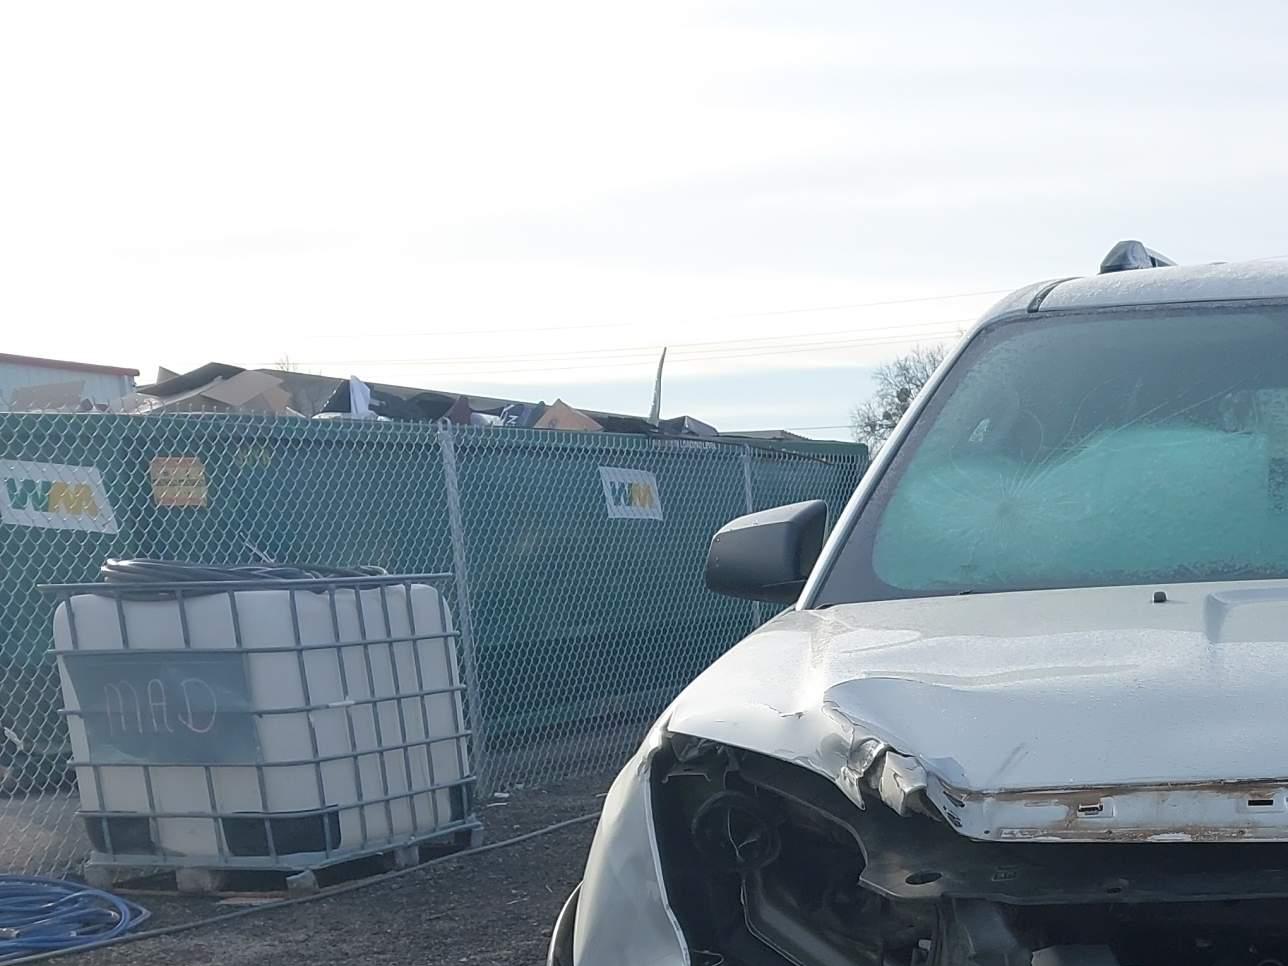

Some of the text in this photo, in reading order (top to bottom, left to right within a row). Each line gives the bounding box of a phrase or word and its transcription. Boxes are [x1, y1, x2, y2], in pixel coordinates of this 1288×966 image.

[7, 477, 100, 517] WM
[609, 480, 655, 508] WM
[103, 678, 217, 737] MAD
